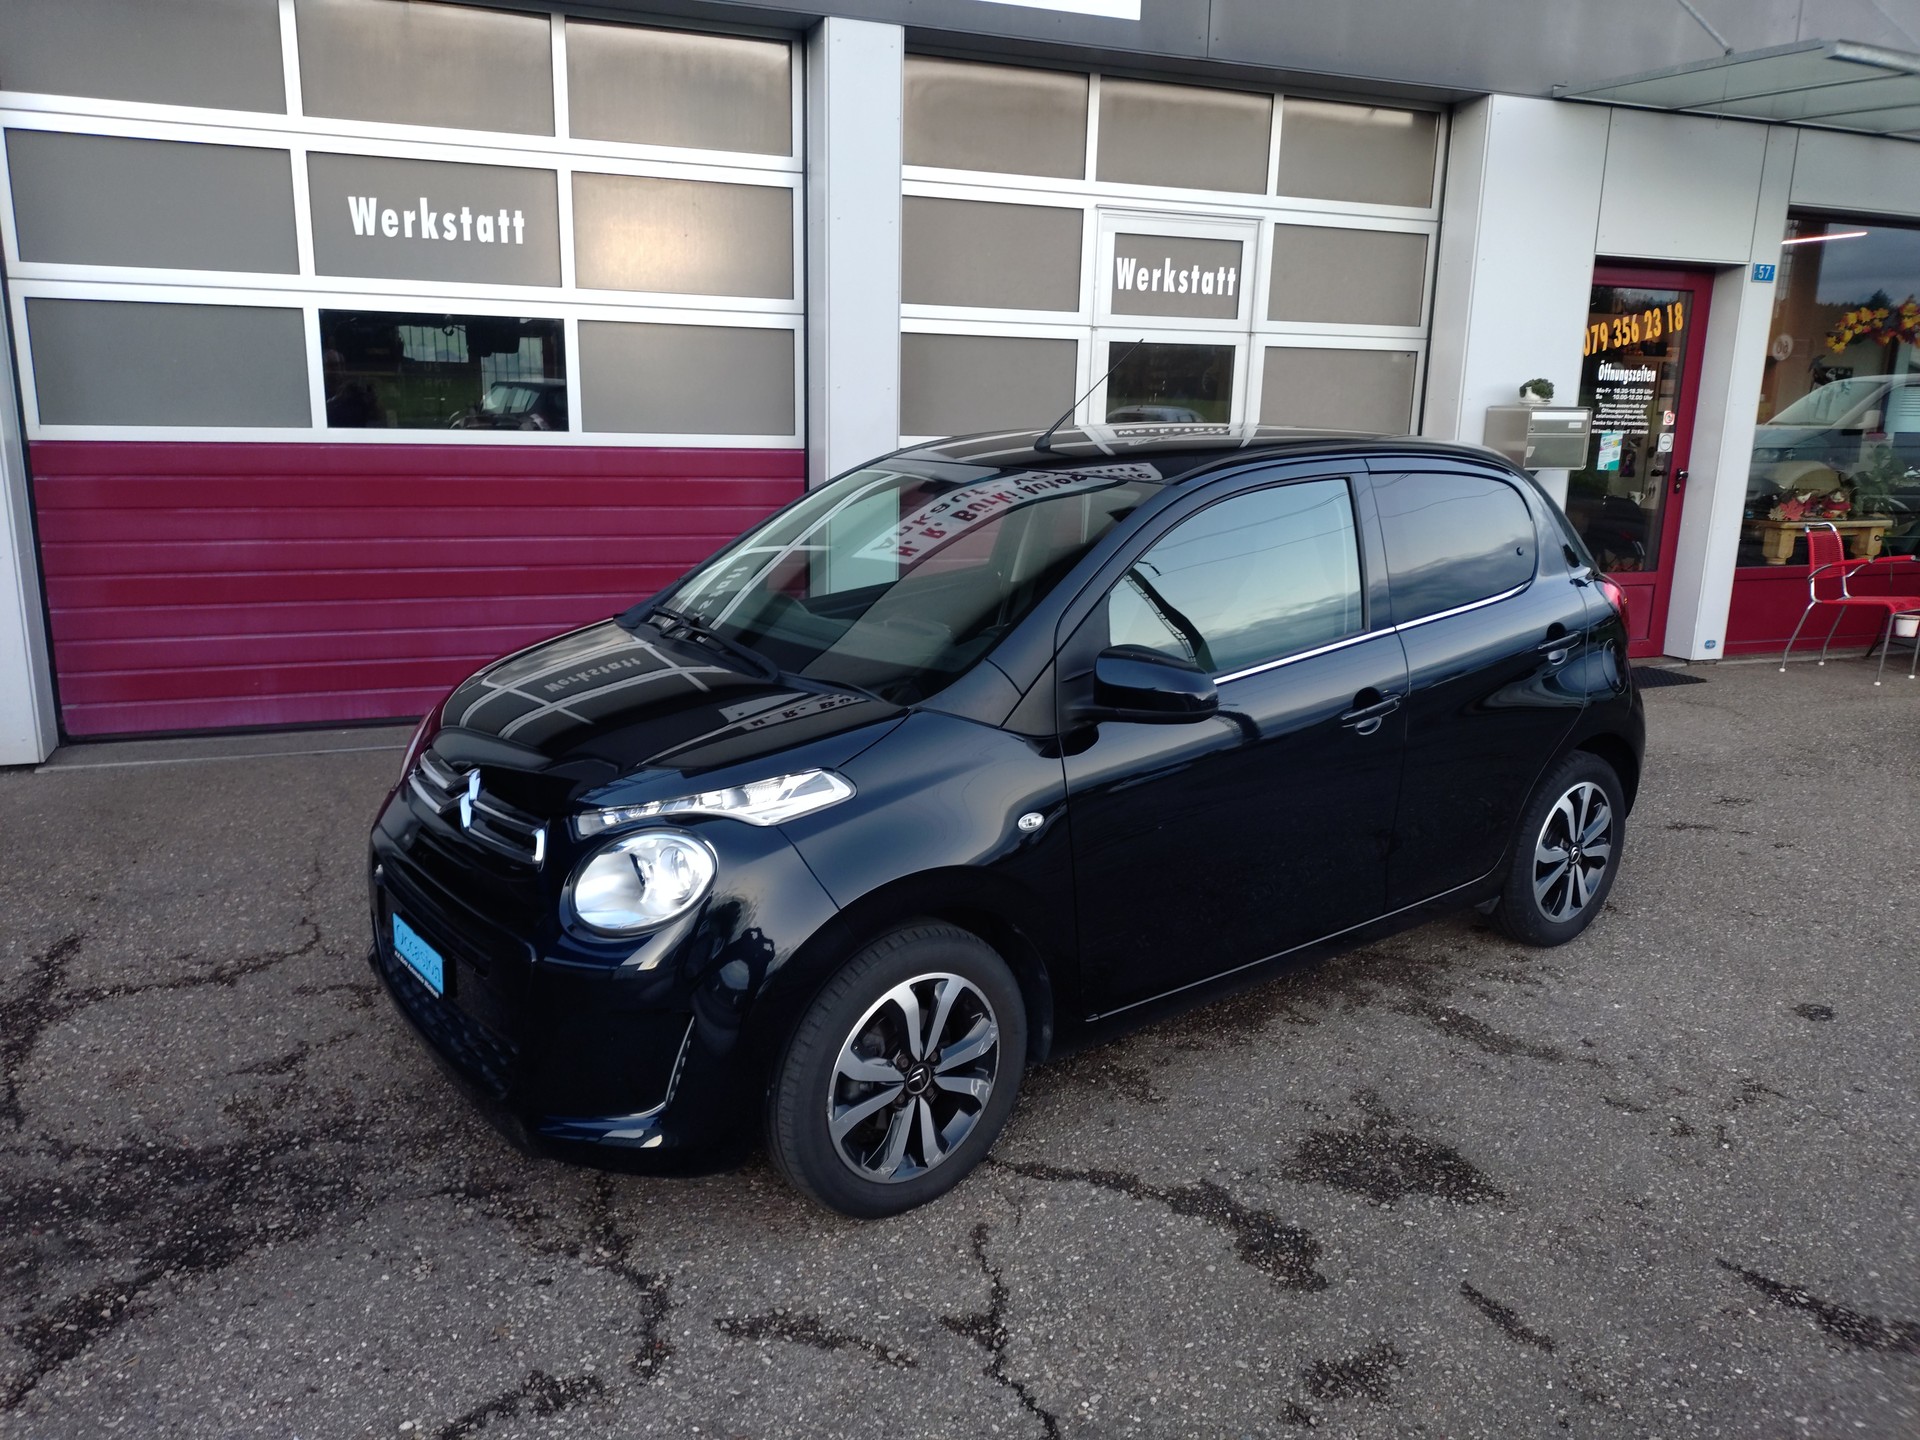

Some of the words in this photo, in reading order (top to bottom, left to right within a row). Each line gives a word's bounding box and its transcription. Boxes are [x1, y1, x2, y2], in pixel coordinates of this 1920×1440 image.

[347, 196, 525, 244] Werkstatt
[1116, 257, 1236, 296] Werkstatt
[1758, 265, 1772, 280] 57
[1583, 321, 1609, 357] 079
[1613, 313, 1640, 348] 356
[1643, 307, 1662, 340] 23
[1666, 301, 1684, 333] 18
[1597, 360, 1657, 385] Öffnungszeiten
